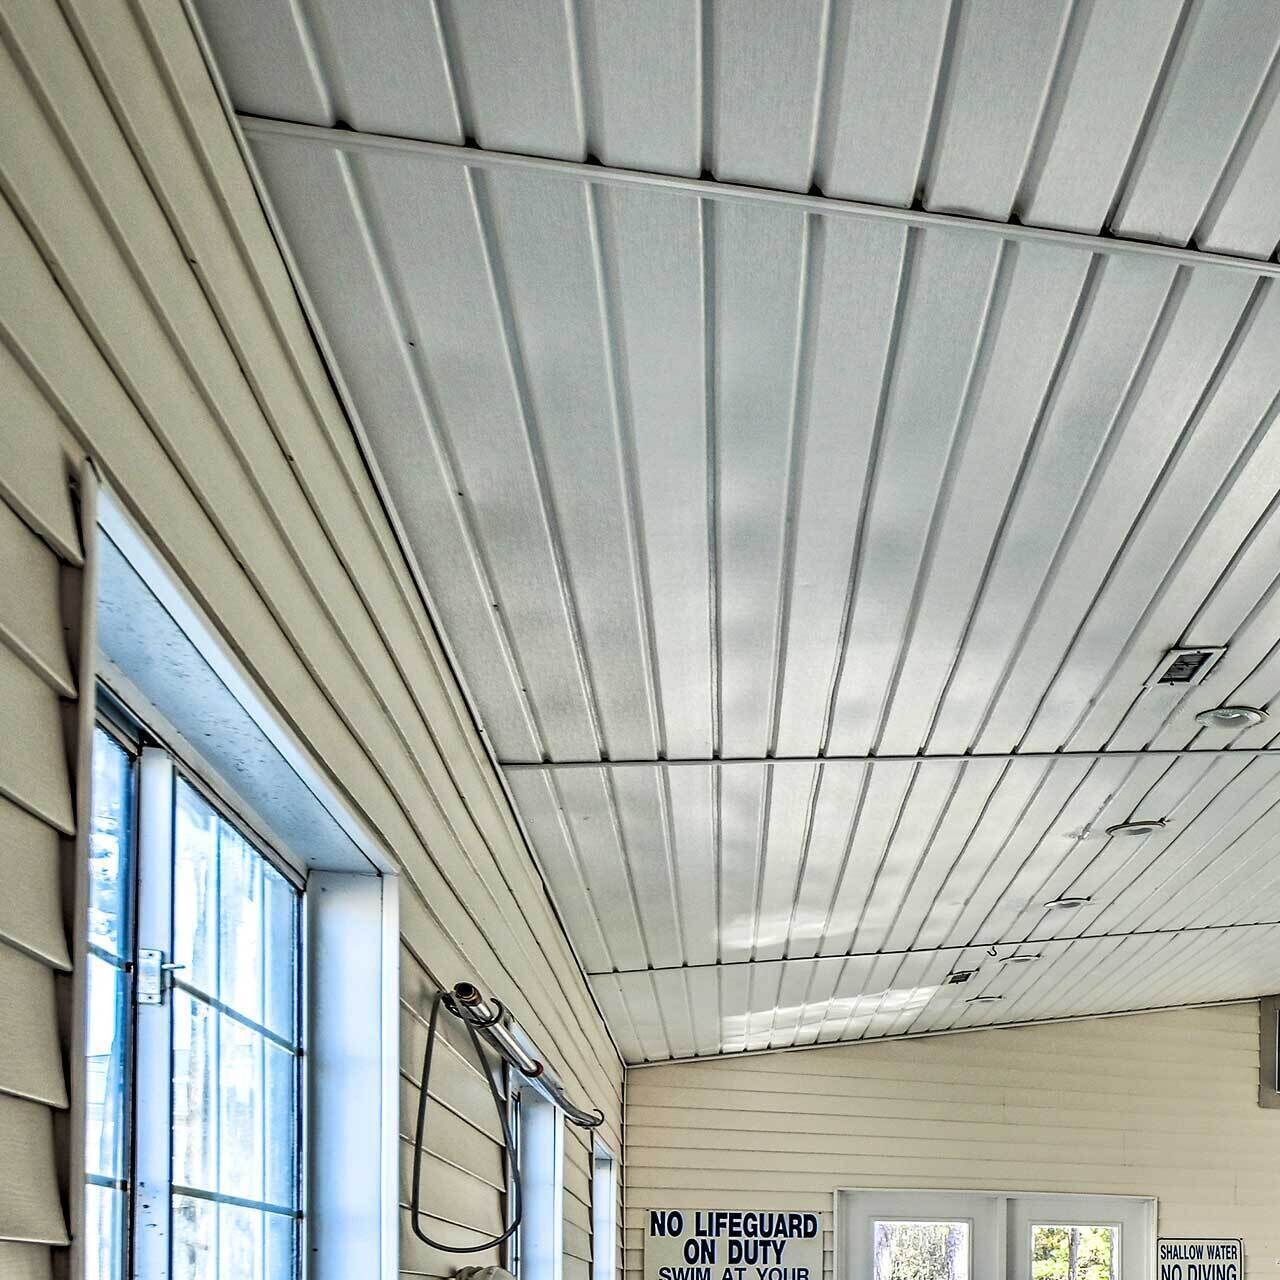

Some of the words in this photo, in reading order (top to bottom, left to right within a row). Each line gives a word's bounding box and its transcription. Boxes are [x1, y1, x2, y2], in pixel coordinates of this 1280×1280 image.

[650, 1211, 683, 1237] NO
[695, 1211, 818, 1239] LIFEGUARD
[683, 1238, 716, 1265] ON
[728, 1239, 786, 1265] DUTY
[1160, 1244, 1204, 1260] SHALLOW
[1206, 1244, 1238, 1260] WATER
